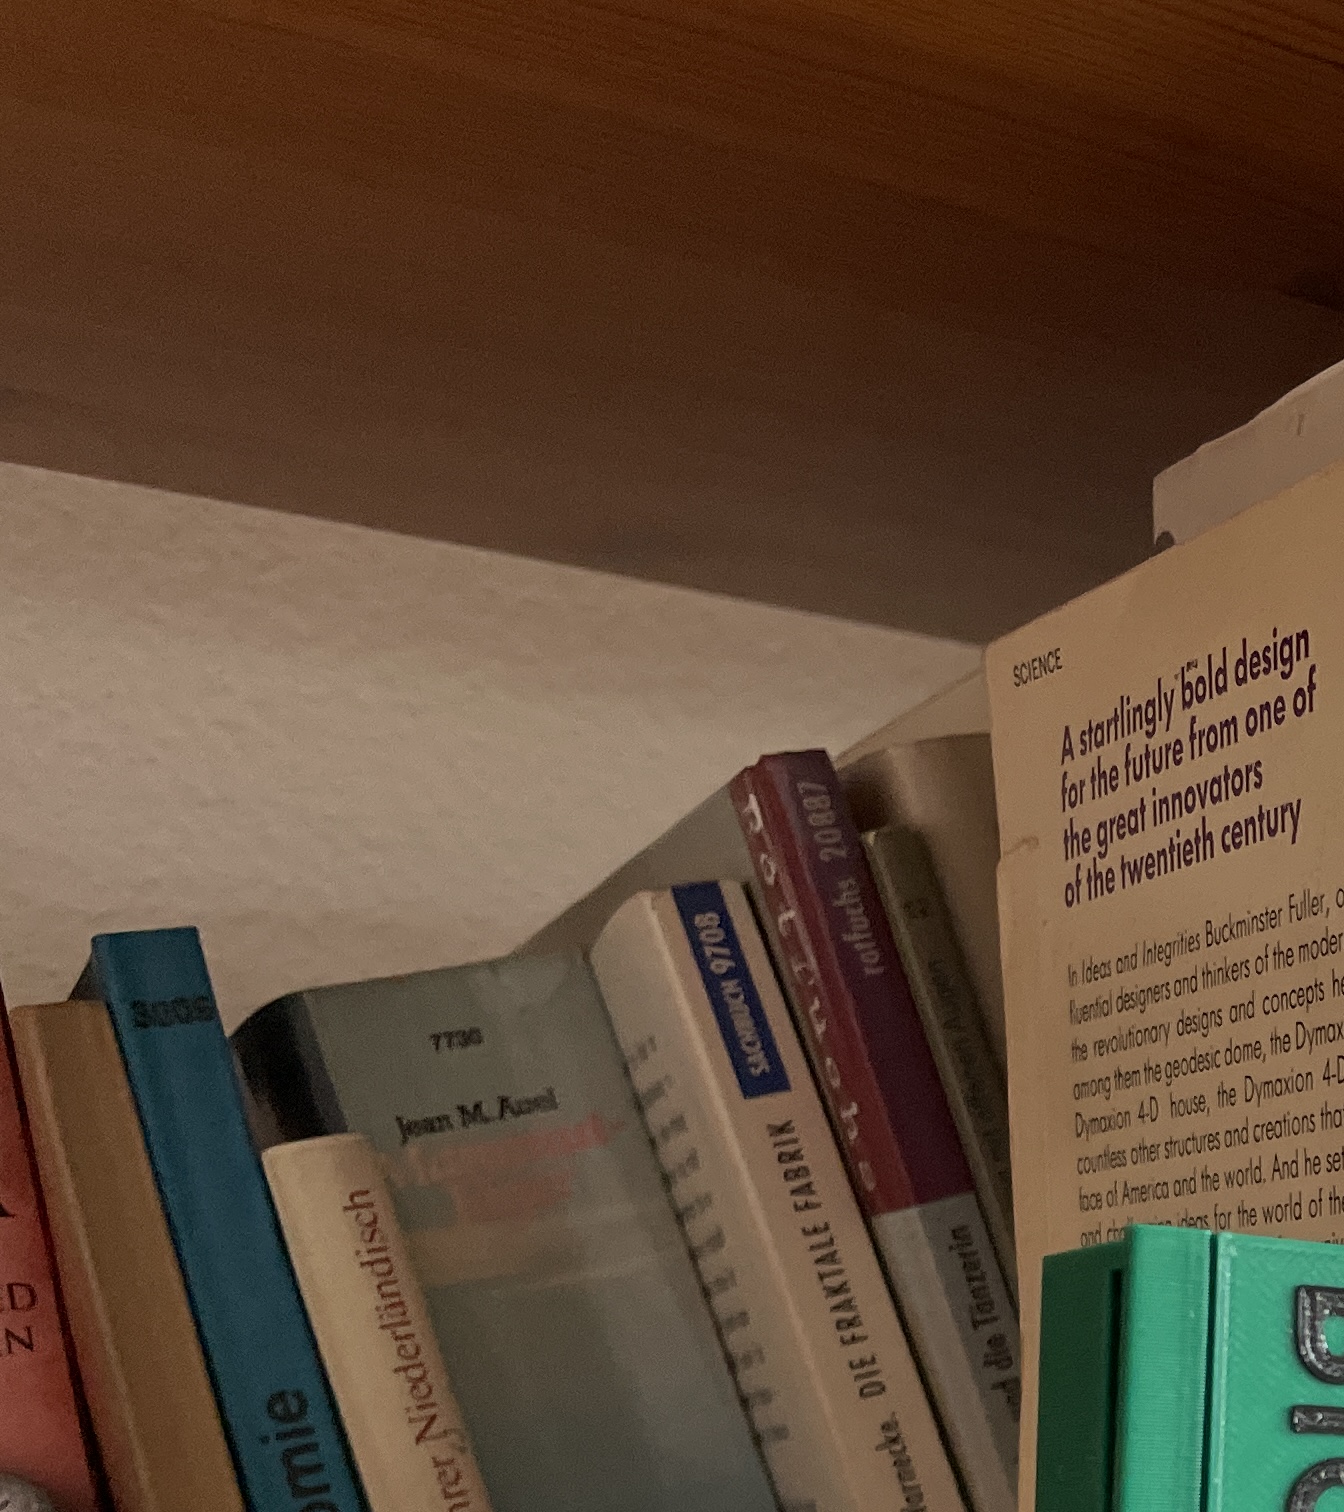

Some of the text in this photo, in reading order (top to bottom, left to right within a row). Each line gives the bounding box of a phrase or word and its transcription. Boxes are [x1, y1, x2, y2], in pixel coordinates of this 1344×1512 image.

[1013, 648, 1062, 687] SCIENCE
[1061, 628, 1310, 765] A startlingly bold design
[1061, 664, 1317, 812] for the future from one of
[1064, 758, 1262, 862] the great innovators
[1065, 798, 1302, 908] of the twentieth century
[1206, 907, 1282, 948] Buckminster
[1289, 891, 1330, 922] Fuller,
[1202, 957, 1249, 992] thinkers
[1255, 947, 1270, 974] of
[1273, 944, 1294, 970] the
[1177, 1005, 1222, 1043] designs
[1230, 999, 1255, 1025] and
[1262, 977, 1325, 1017] concepts
[1164, 1044, 1221, 1084] geodesic
[1224, 1038, 1266, 1070] dome,
[1270, 1032, 1291, 1056] the
[1170, 1087, 1210, 1118] house,
[1217, 1082, 1236, 1108] the
[1244, 1067, 1314, 1106] Dymaxion
[1224, 1116, 1249, 1148] and
[1253, 1102, 1315, 1143] creations
[1201, 1165, 1220, 1192] the
[1224, 1157, 1266, 1189] world.
[1272, 1149, 1299, 1180] And
[1304, 1148, 1320, 1174] he
[1214, 1205, 1232, 1231] for
[1238, 1205, 1257, 1229] the
[1262, 1196, 1302, 1224] world
[1308, 1189, 1324, 1218] of
[766, 1117, 887, 1402] DIE FRAKTALE FABRIK
[342, 1186, 450, 1448] Niederländisch
